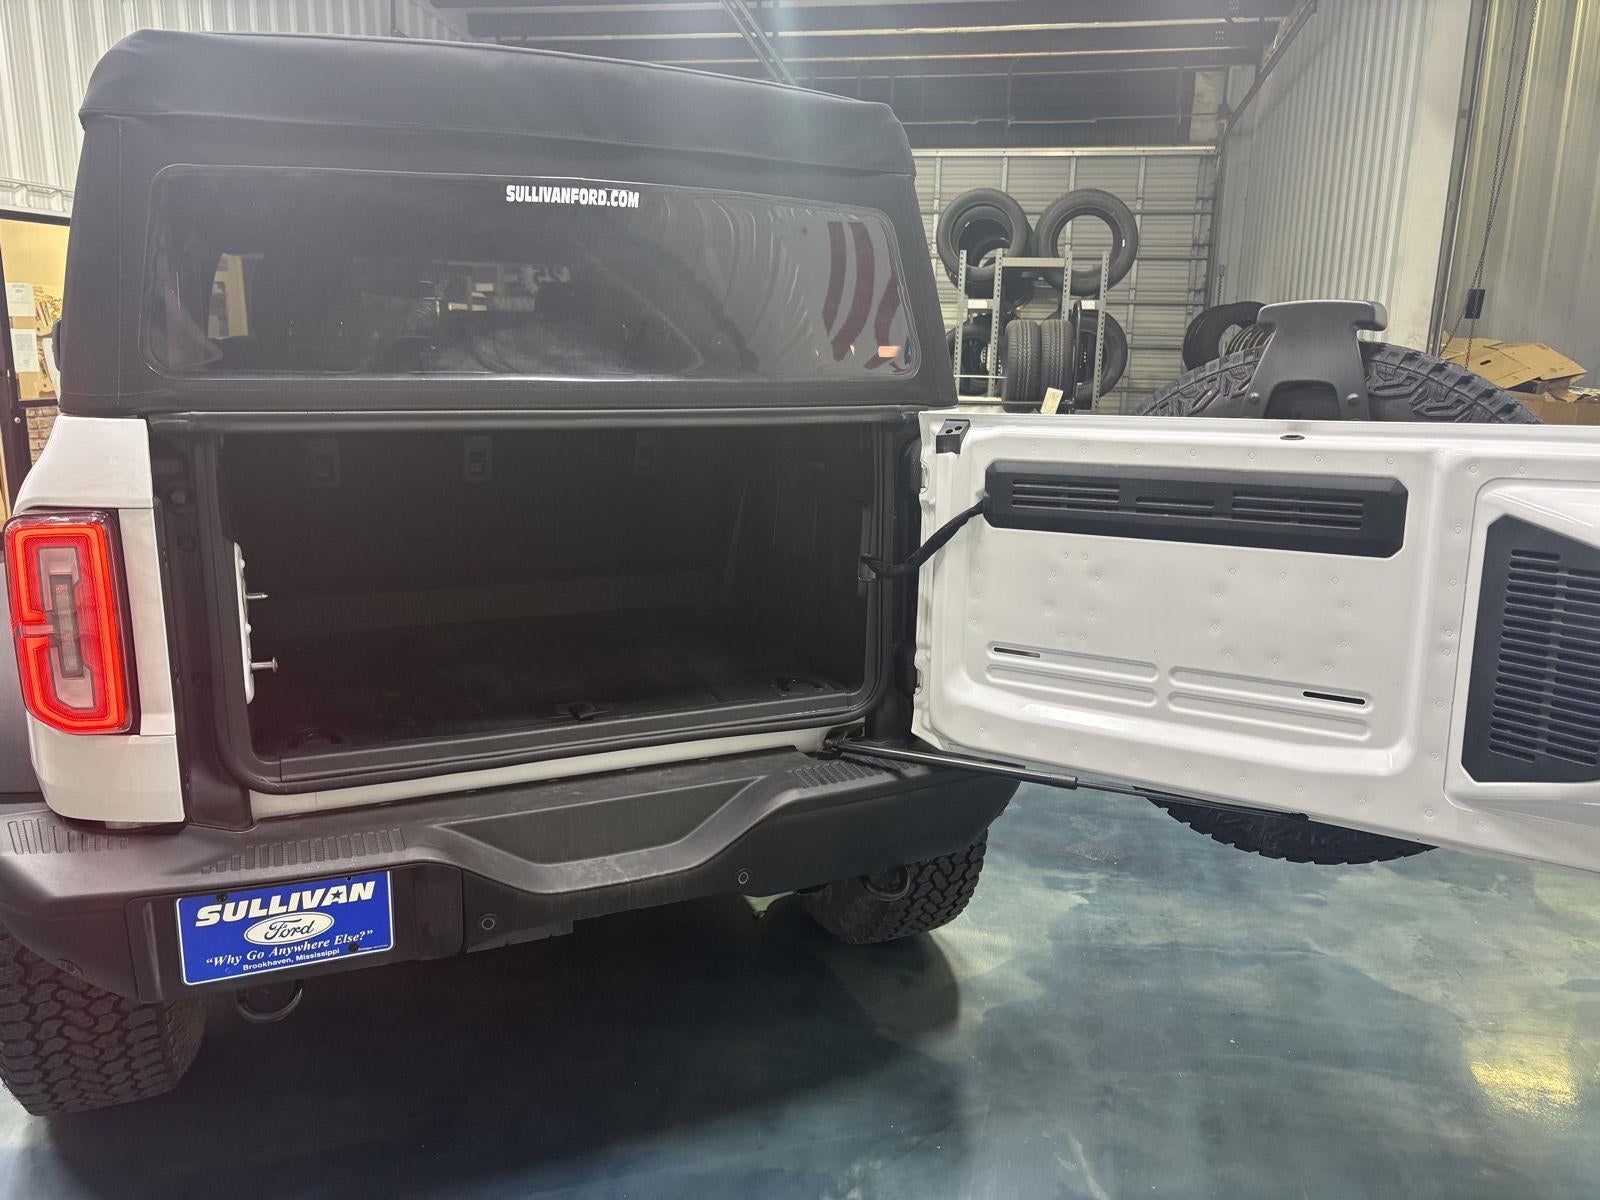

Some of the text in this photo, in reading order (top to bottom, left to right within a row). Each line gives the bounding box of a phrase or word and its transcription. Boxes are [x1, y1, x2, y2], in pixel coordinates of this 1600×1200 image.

[505, 184, 640, 208] SULLIVANFORD.COM
[195, 881, 376, 927] SULLIVAN
[264, 918, 315, 941] Ford
[243, 948, 340, 971] Brookhaven, Mississippi
[246, 949, 265, 961] Go
[268, 939, 330, 957] Anywhere
